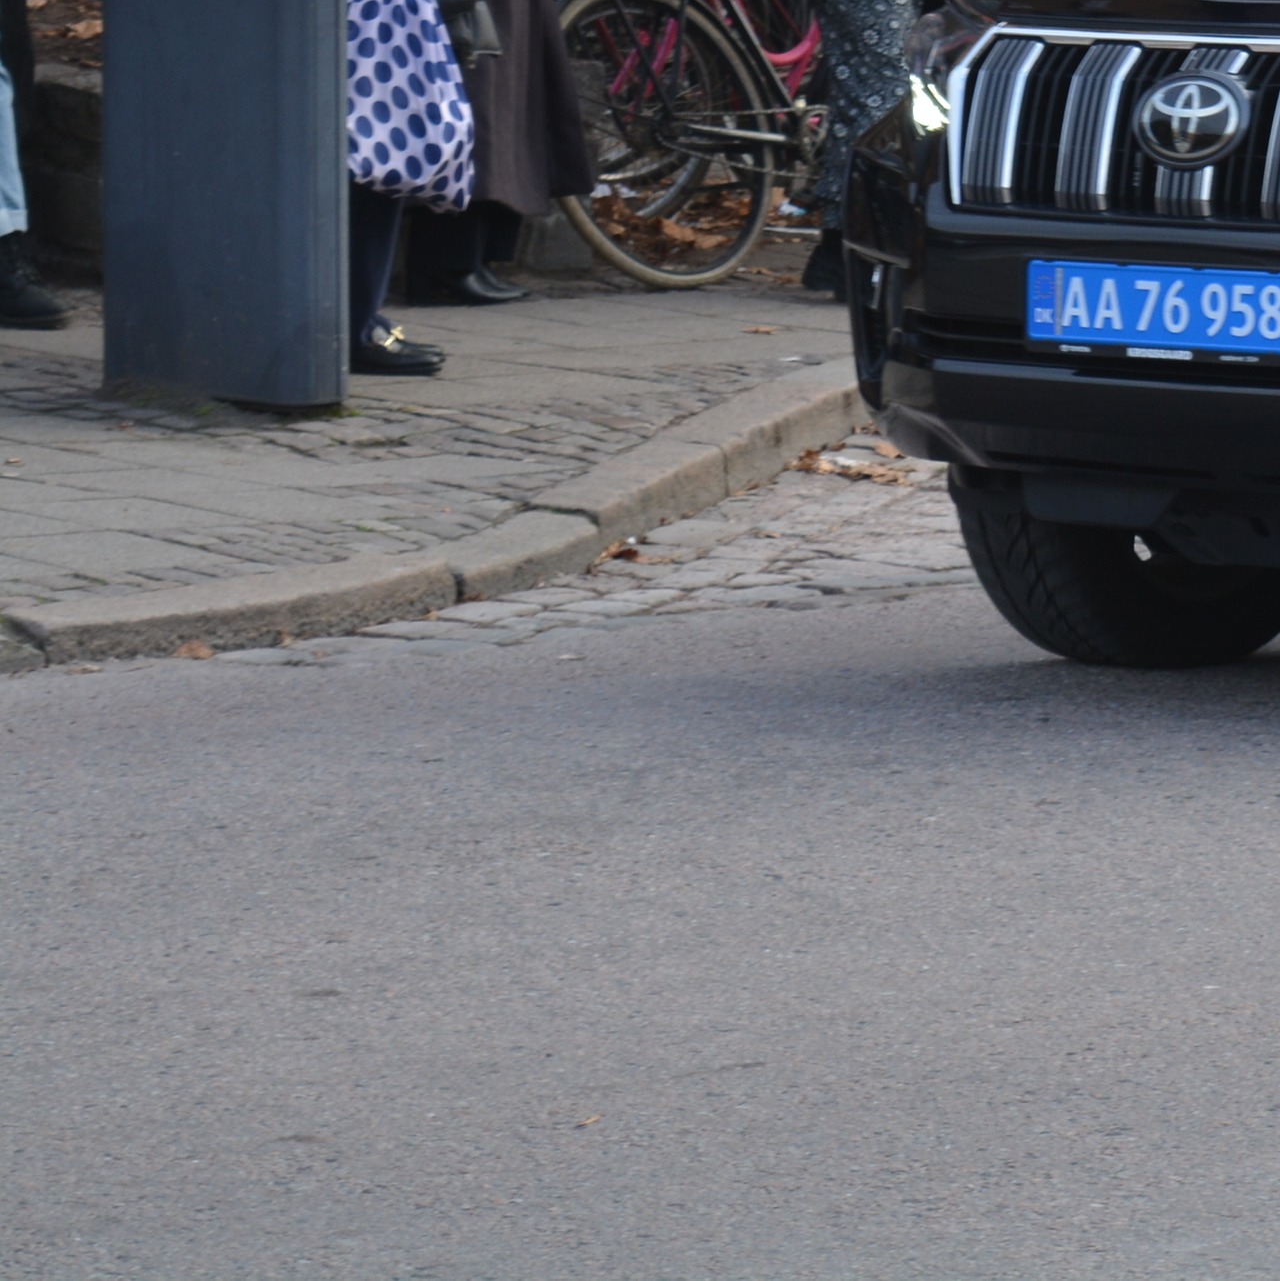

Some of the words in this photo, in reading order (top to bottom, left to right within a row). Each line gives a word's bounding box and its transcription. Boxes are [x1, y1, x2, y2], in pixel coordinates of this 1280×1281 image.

[1033, 306, 1055, 324] DK
[1061, 276, 1124, 331] AA
[1134, 280, 1190, 334] 76
